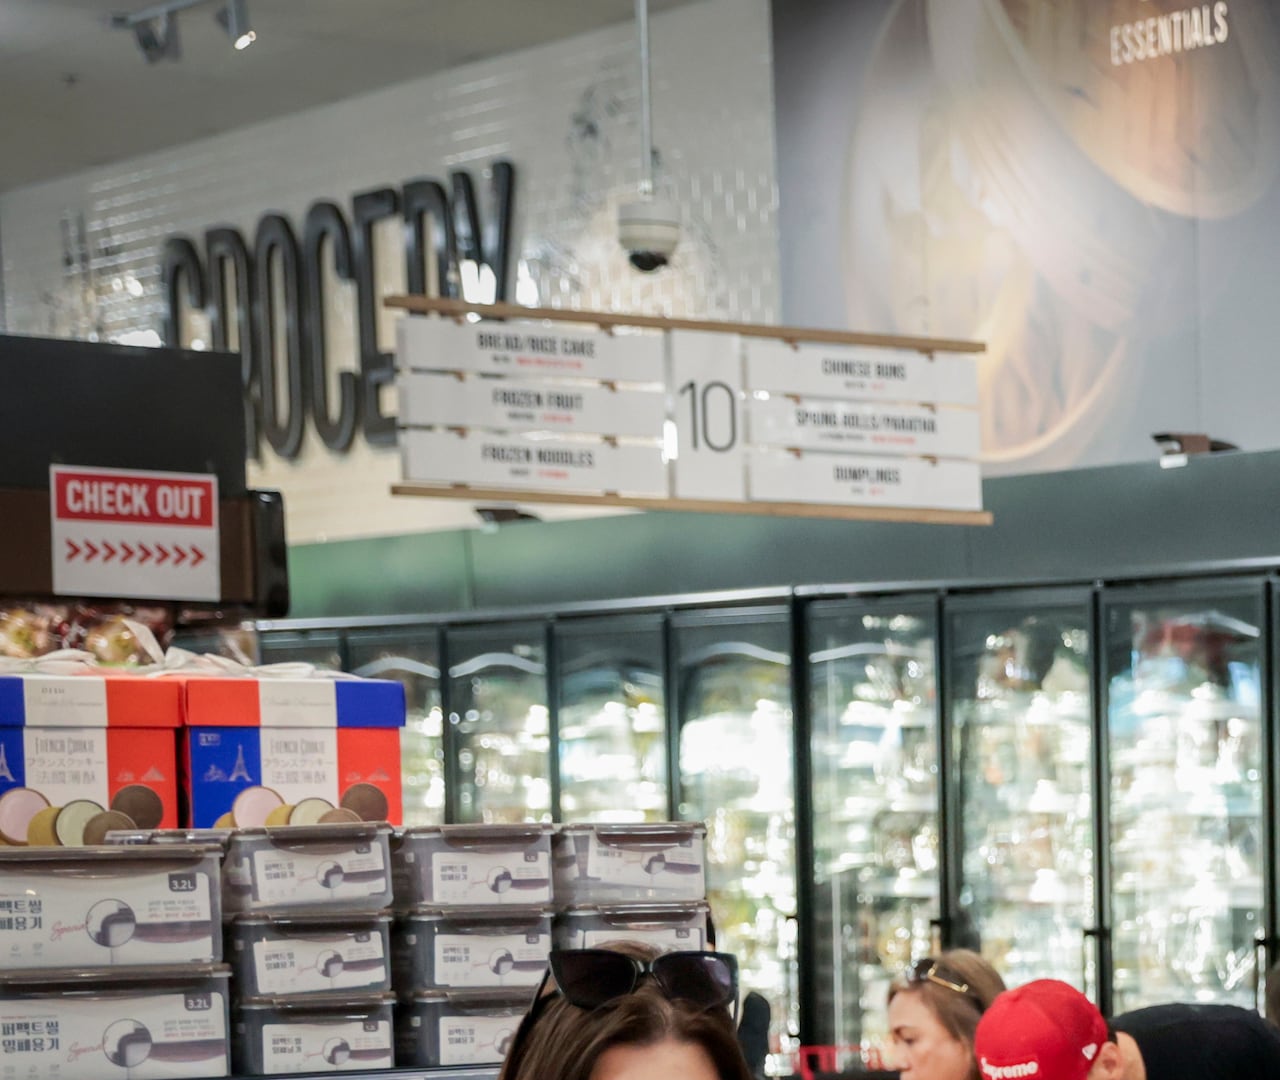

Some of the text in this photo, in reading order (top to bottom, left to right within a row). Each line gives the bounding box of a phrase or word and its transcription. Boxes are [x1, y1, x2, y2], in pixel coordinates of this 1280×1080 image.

[1110, 1, 1228, 66] ESSENTIALS
[679, 379, 737, 453] 10
[66, 479, 206, 520] CHECK OUT
[172, 879, 194, 891] 3.2L
[187, 998, 210, 1010] 3.2L
